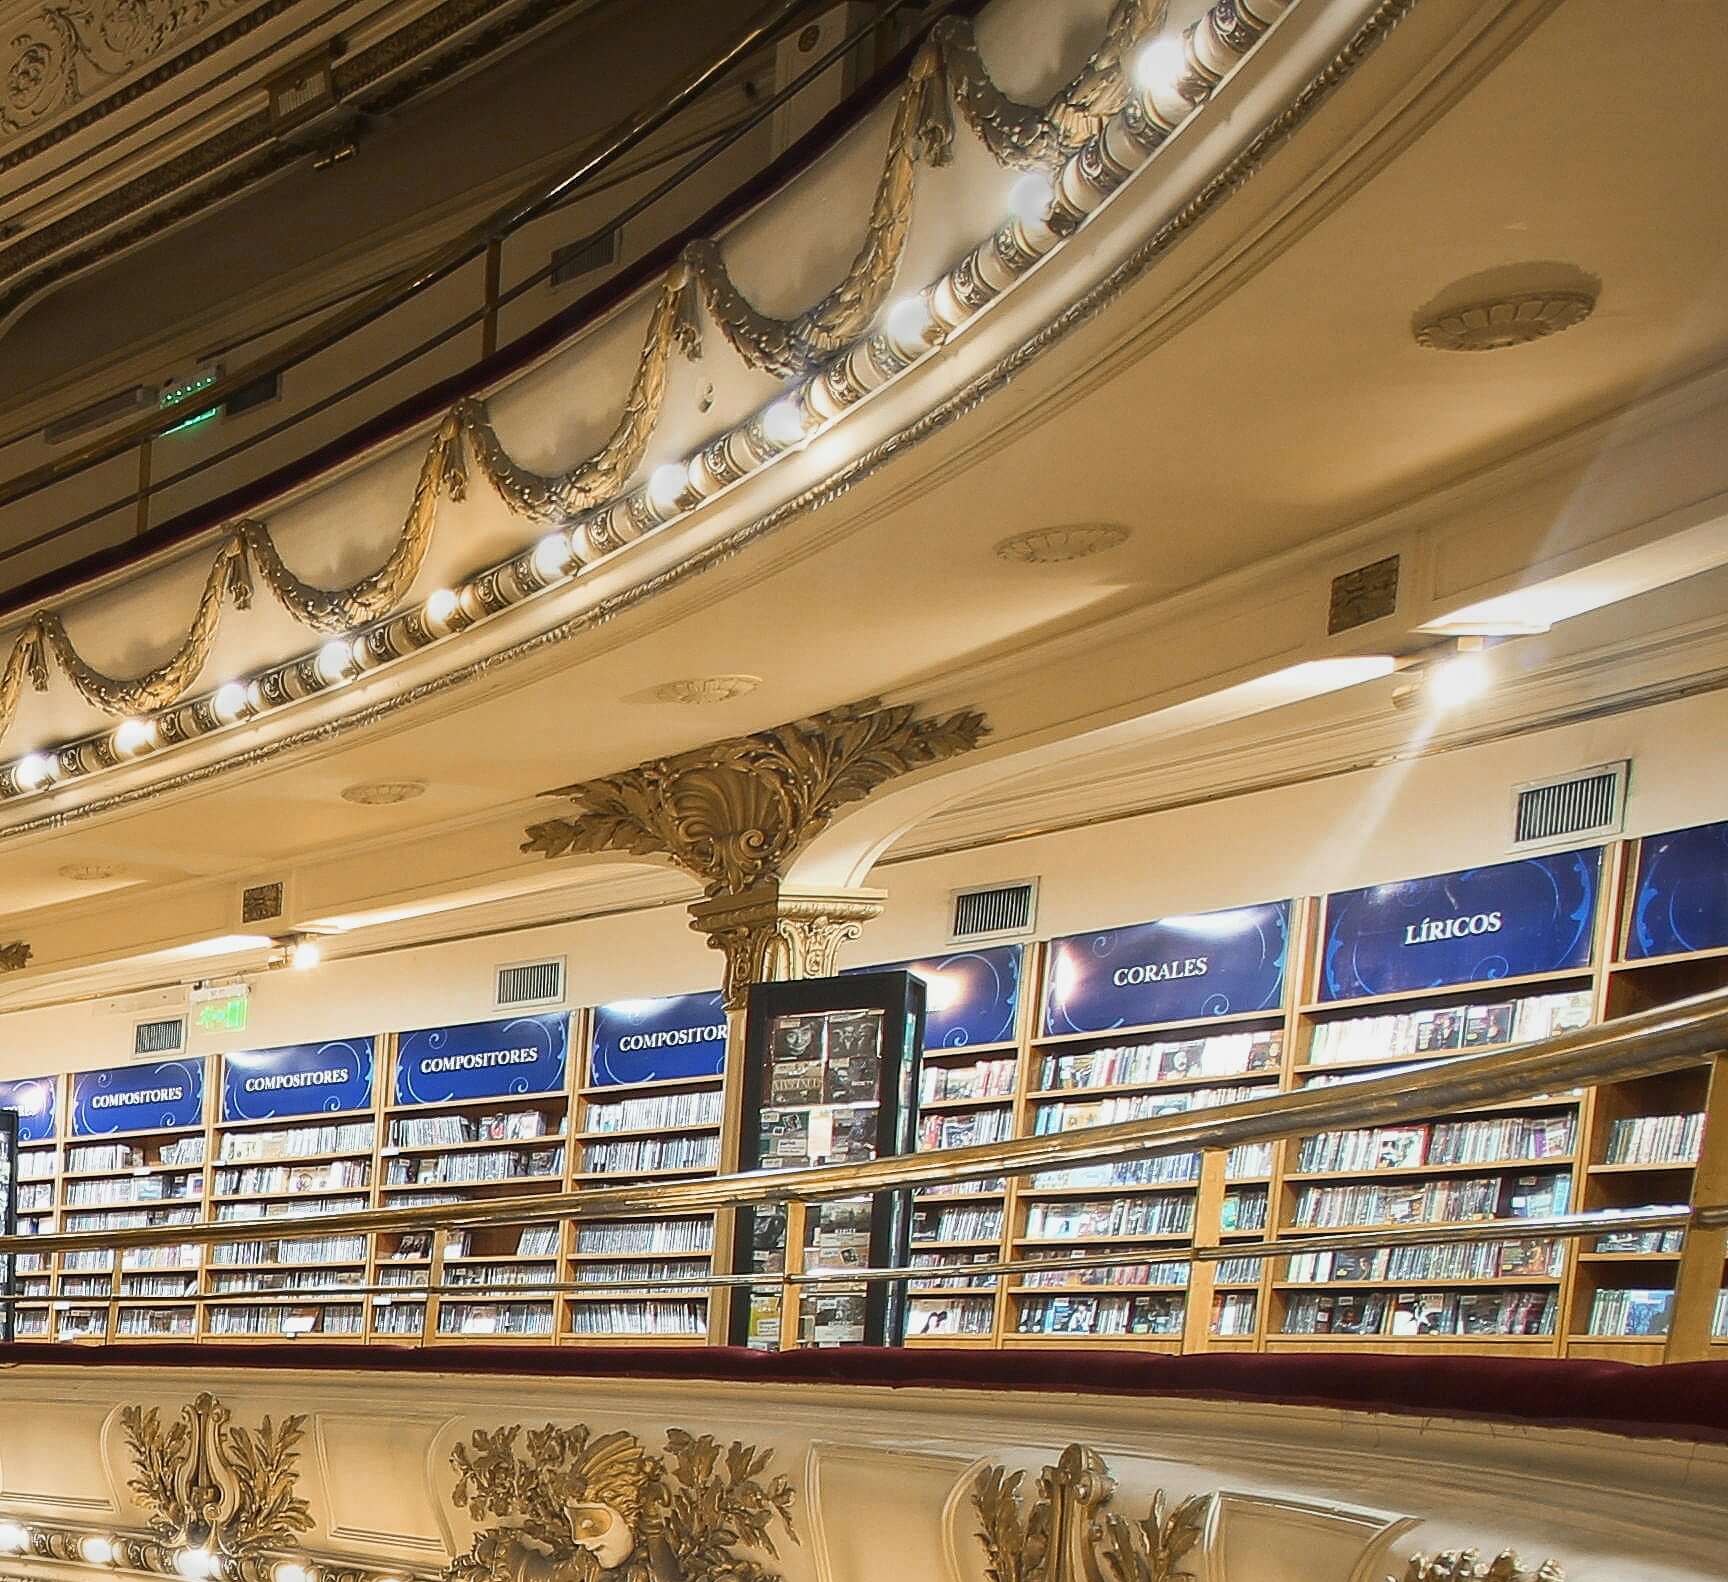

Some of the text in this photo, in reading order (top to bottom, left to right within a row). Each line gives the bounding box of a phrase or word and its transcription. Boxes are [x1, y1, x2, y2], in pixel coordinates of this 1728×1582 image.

[1404, 910, 1503, 946] LÍRICOS
[1112, 955, 1209, 988] CORALES
[420, 1046, 539, 1075] COMPOSITORES
[244, 1067, 349, 1093] COMPOSITORES
[91, 1085, 183, 1109] COMPOSITORES
